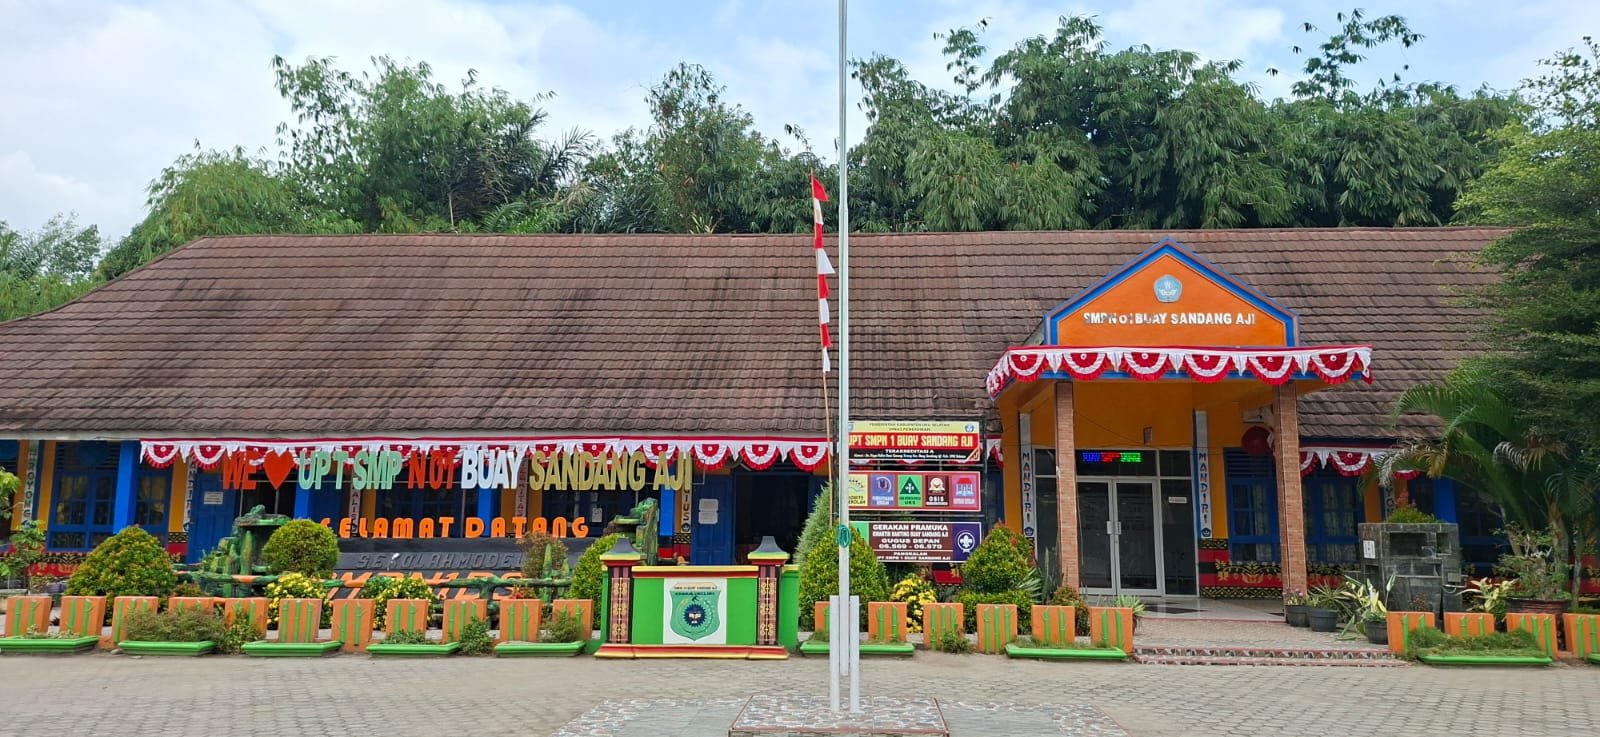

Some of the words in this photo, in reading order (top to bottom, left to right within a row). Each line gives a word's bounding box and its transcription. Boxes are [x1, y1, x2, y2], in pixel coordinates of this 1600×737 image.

[1083, 312, 1117, 325] SMPN
[1171, 312, 1232, 325] SANDANG
[1235, 313, 1255, 325] AJI
[865, 435, 888, 446] SMPN
[890, 435, 895, 447] 1
[897, 435, 918, 447] BUAY
[921, 435, 958, 447] SANDANG
[961, 435, 973, 447] AJI
[222, 448, 257, 490] WE
[298, 449, 349, 490] UPT
[353, 449, 403, 490] SMP
[461, 449, 525, 490] BUAY
[529, 451, 646, 491] SANDANG
[653, 451, 692, 491] AJI
[1022, 452, 1032, 523] MANDIRI
[1198, 452, 1209, 524] MANDIRI
[465, 516, 590, 539] DATANG
